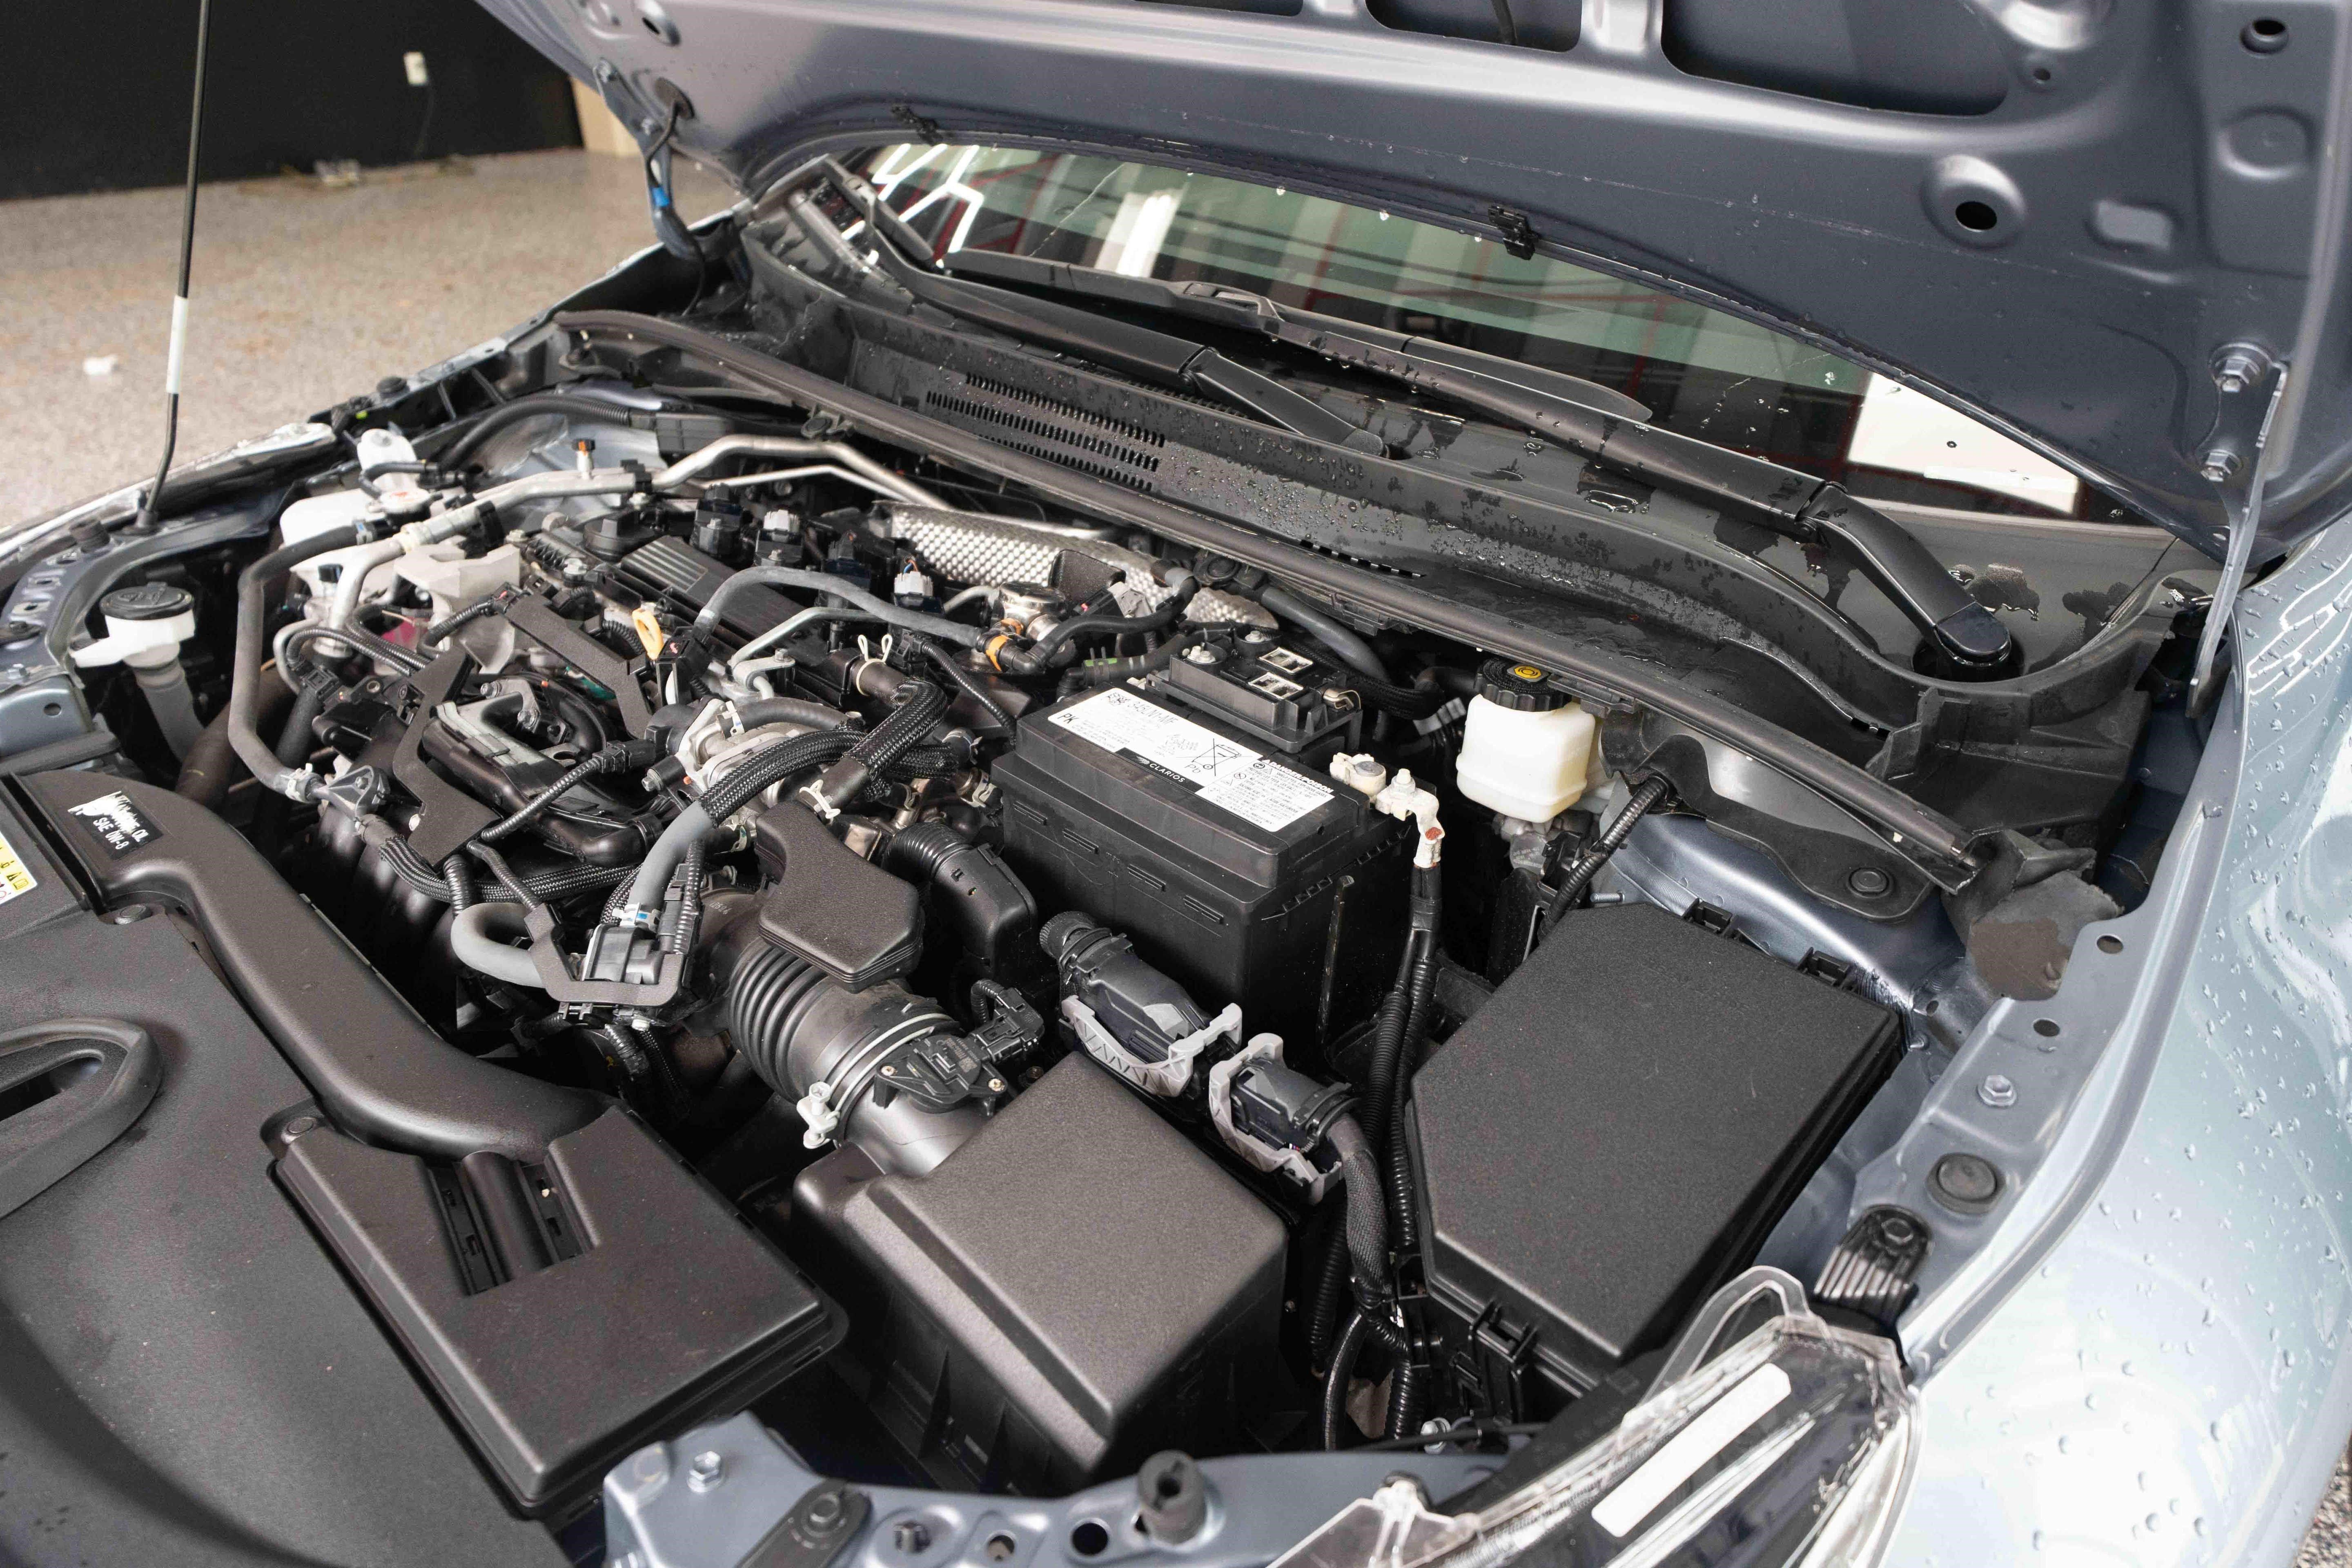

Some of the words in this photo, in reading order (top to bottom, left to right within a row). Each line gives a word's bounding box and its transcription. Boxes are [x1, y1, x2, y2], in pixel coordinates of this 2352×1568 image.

[1057, 713, 1079, 724] PK
[1149, 763, 1185, 782] CLARIOS
[1184, 764, 1200, 773] Pb
[1269, 761, 1334, 793] DANGER/POISON
[93, 817, 114, 832] SAE
[105, 830, 129, 850] 0W-8
[132, 829, 149, 842] OIL
